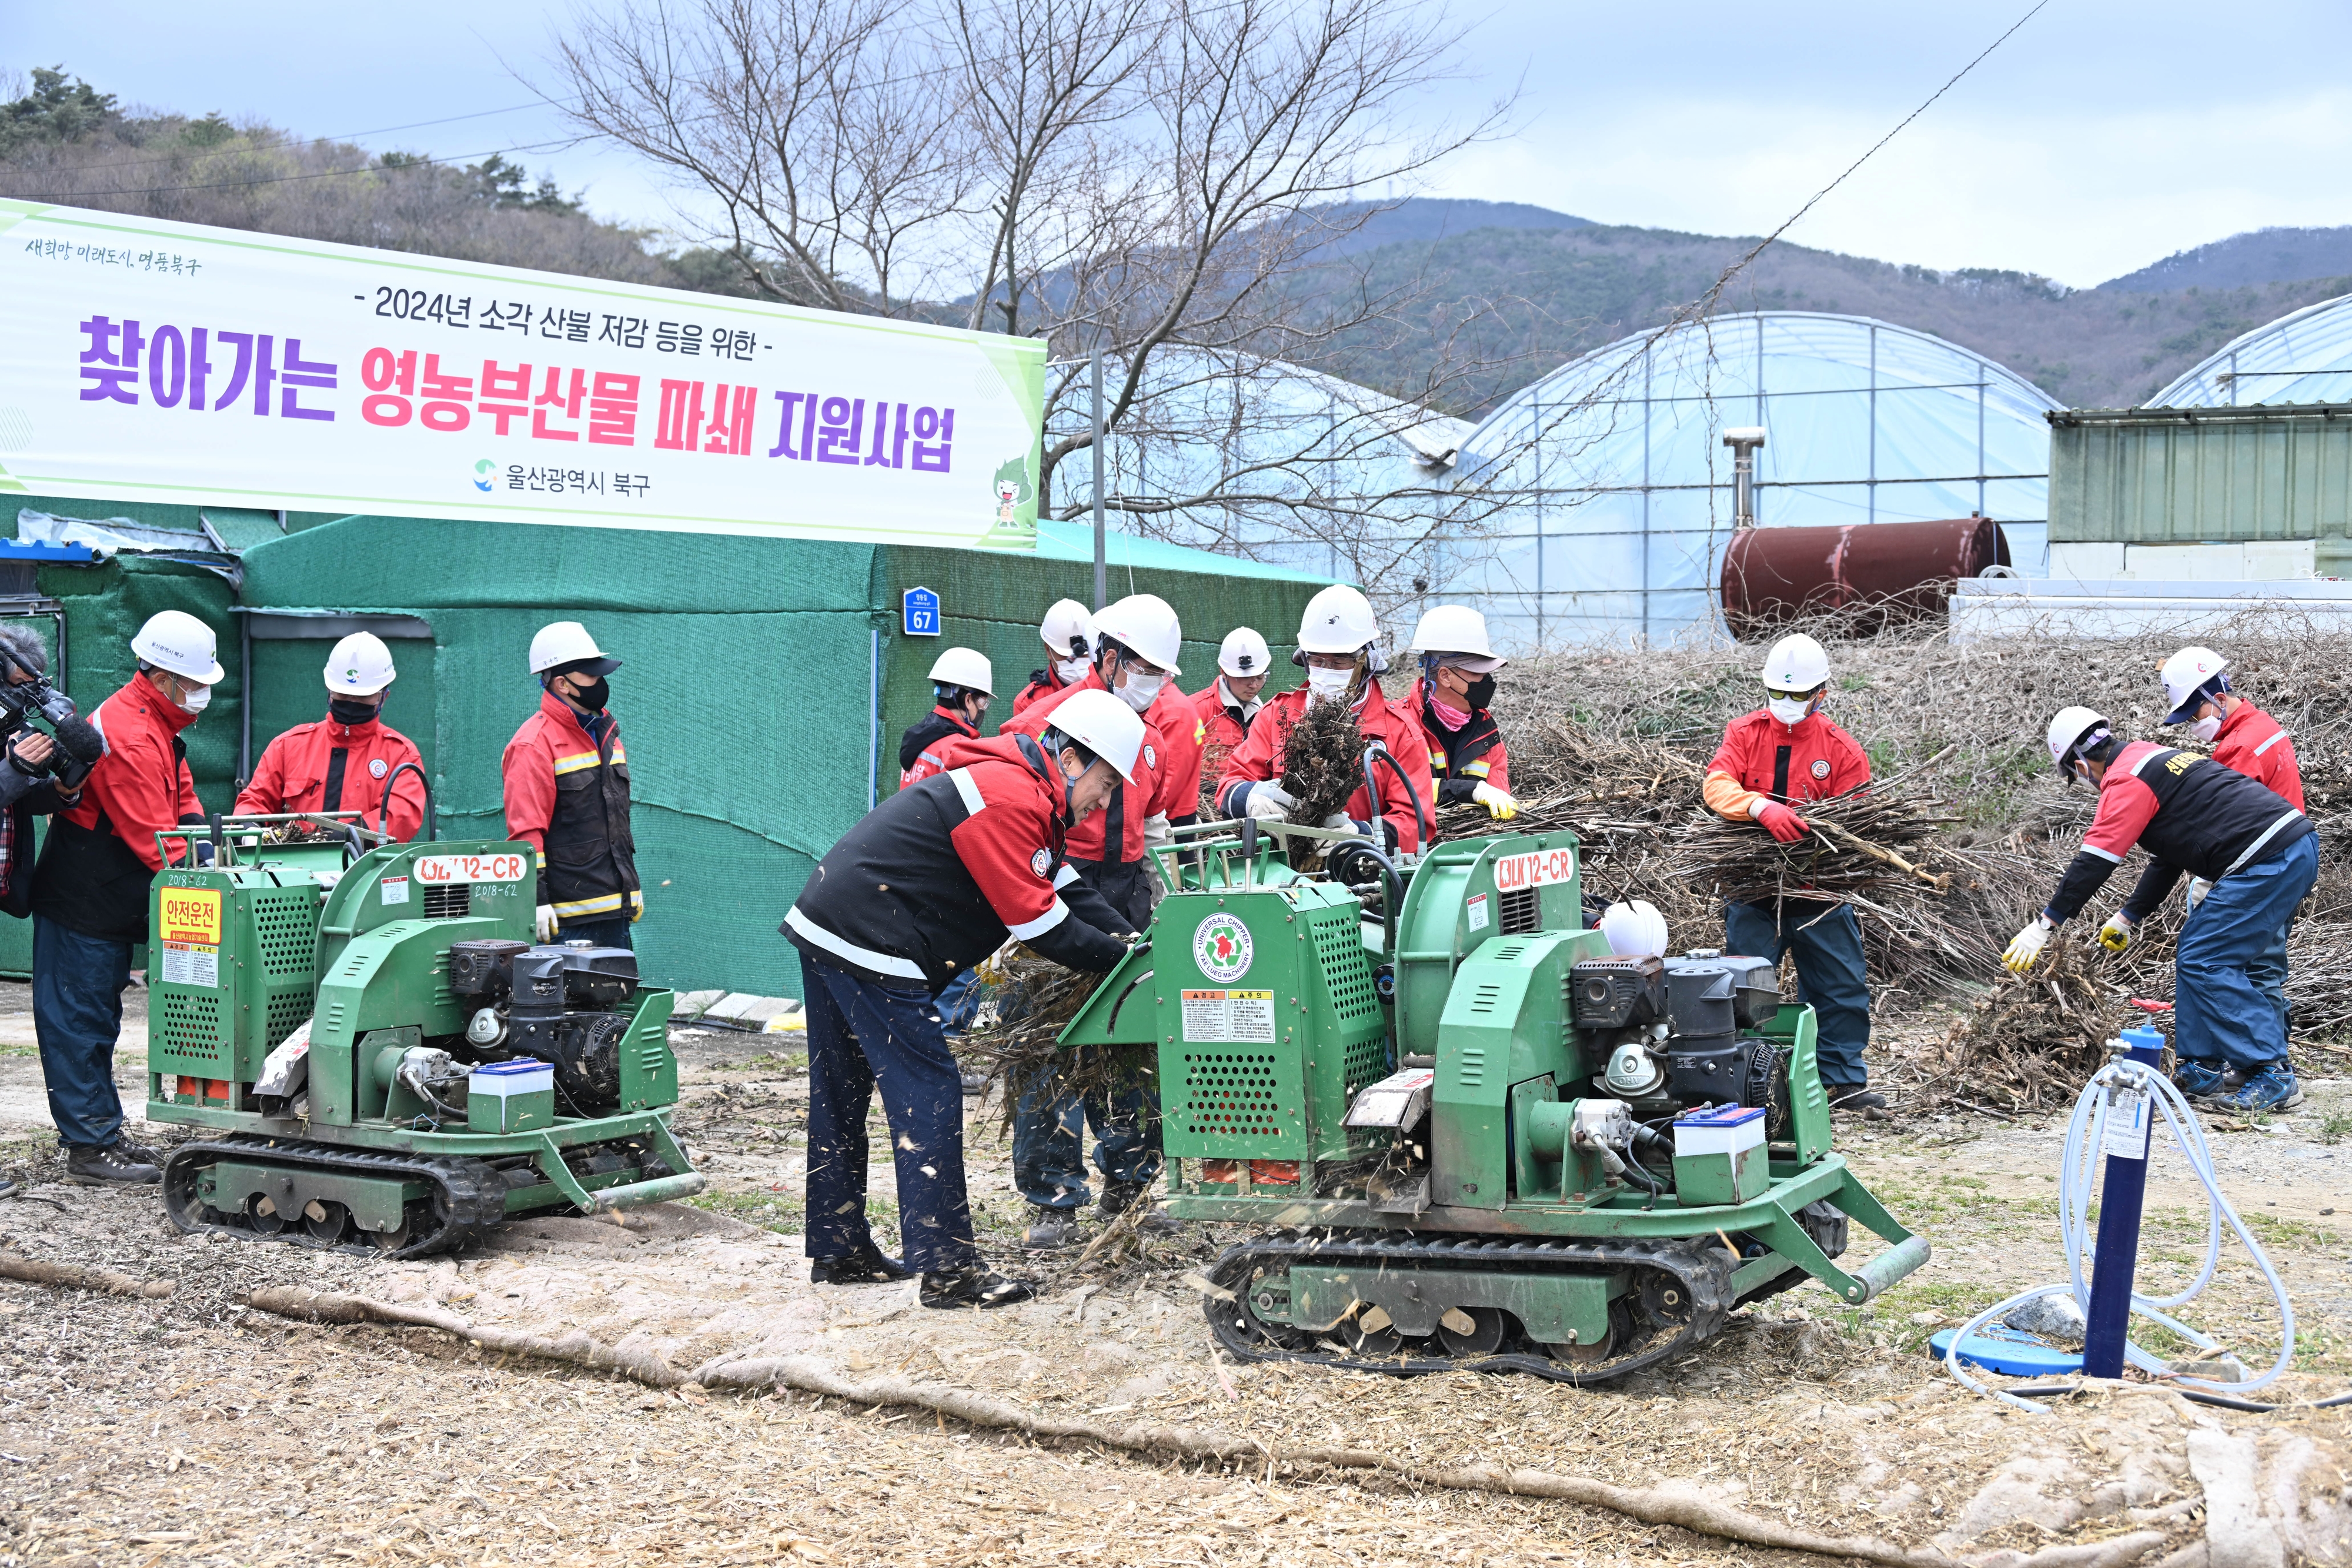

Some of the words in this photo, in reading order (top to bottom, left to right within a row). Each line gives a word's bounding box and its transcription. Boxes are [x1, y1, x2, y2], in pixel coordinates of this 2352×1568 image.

[25, 238, 74, 260] 새희망
[376, 286, 472, 328] 2024년
[479, 300, 533, 336] 소각
[539, 307, 591, 343] 산불
[598, 314, 649, 349] 저감
[656, 321, 703, 356] 등을
[710, 328, 757, 362] 위한
[79, 315, 338, 422] 찾아가는
[361, 347, 641, 447] 영농부산물
[654, 378, 758, 456] 파쇄
[769, 390, 955, 474] 지원사업
[506, 464, 604, 496] 울산광역시
[613, 472, 650, 498] 북구
[913, 611, 931, 629] 67
[151, 641, 174, 656] 울산광역시
[16, 760, 35, 773] FUJINON
[475, 884, 517, 898] 2018-62
[167, 900, 213, 928] 안전운전
[1198, 917, 1225, 945] UNIVERSAL
[1228, 918, 1250, 944] CHIPPER
[1200, 953, 1208, 967] TAE
[1207, 965, 1222, 978] LUEG
[1223, 952, 1250, 978] MACHINERY
[1618, 1076, 1642, 1085] OHV
